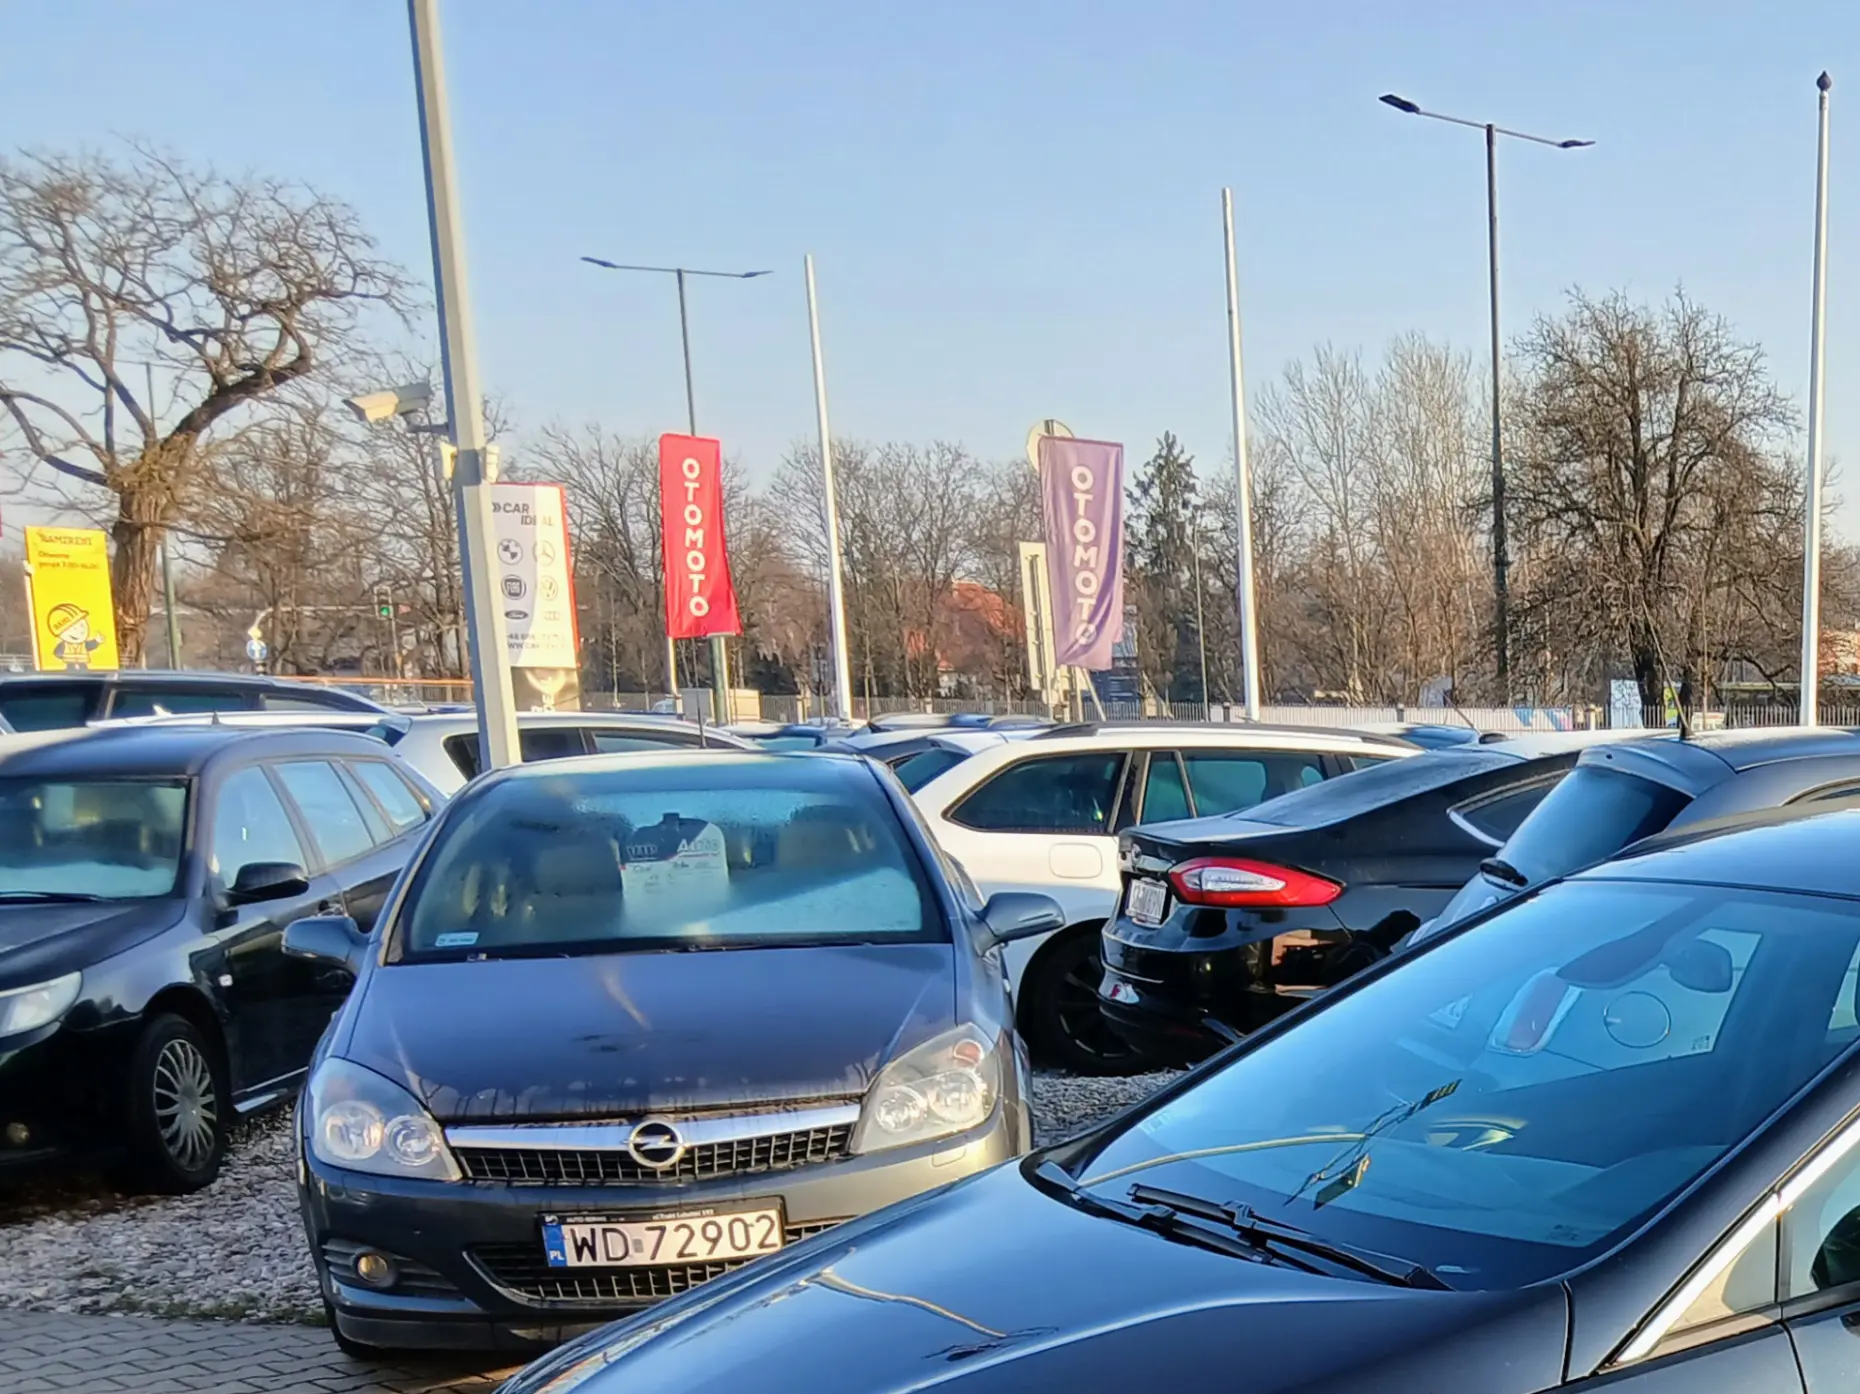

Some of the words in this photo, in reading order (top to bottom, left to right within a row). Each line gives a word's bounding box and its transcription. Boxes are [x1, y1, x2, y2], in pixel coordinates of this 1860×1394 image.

[503, 502, 530, 514] CAR
[682, 457, 709, 617] OTOMOTO
[1071, 465, 1098, 645] OTOMOTO
[550, 1251, 564, 1261] PL
[570, 1227, 630, 1262] WD
[645, 1214, 778, 1261] 72902
